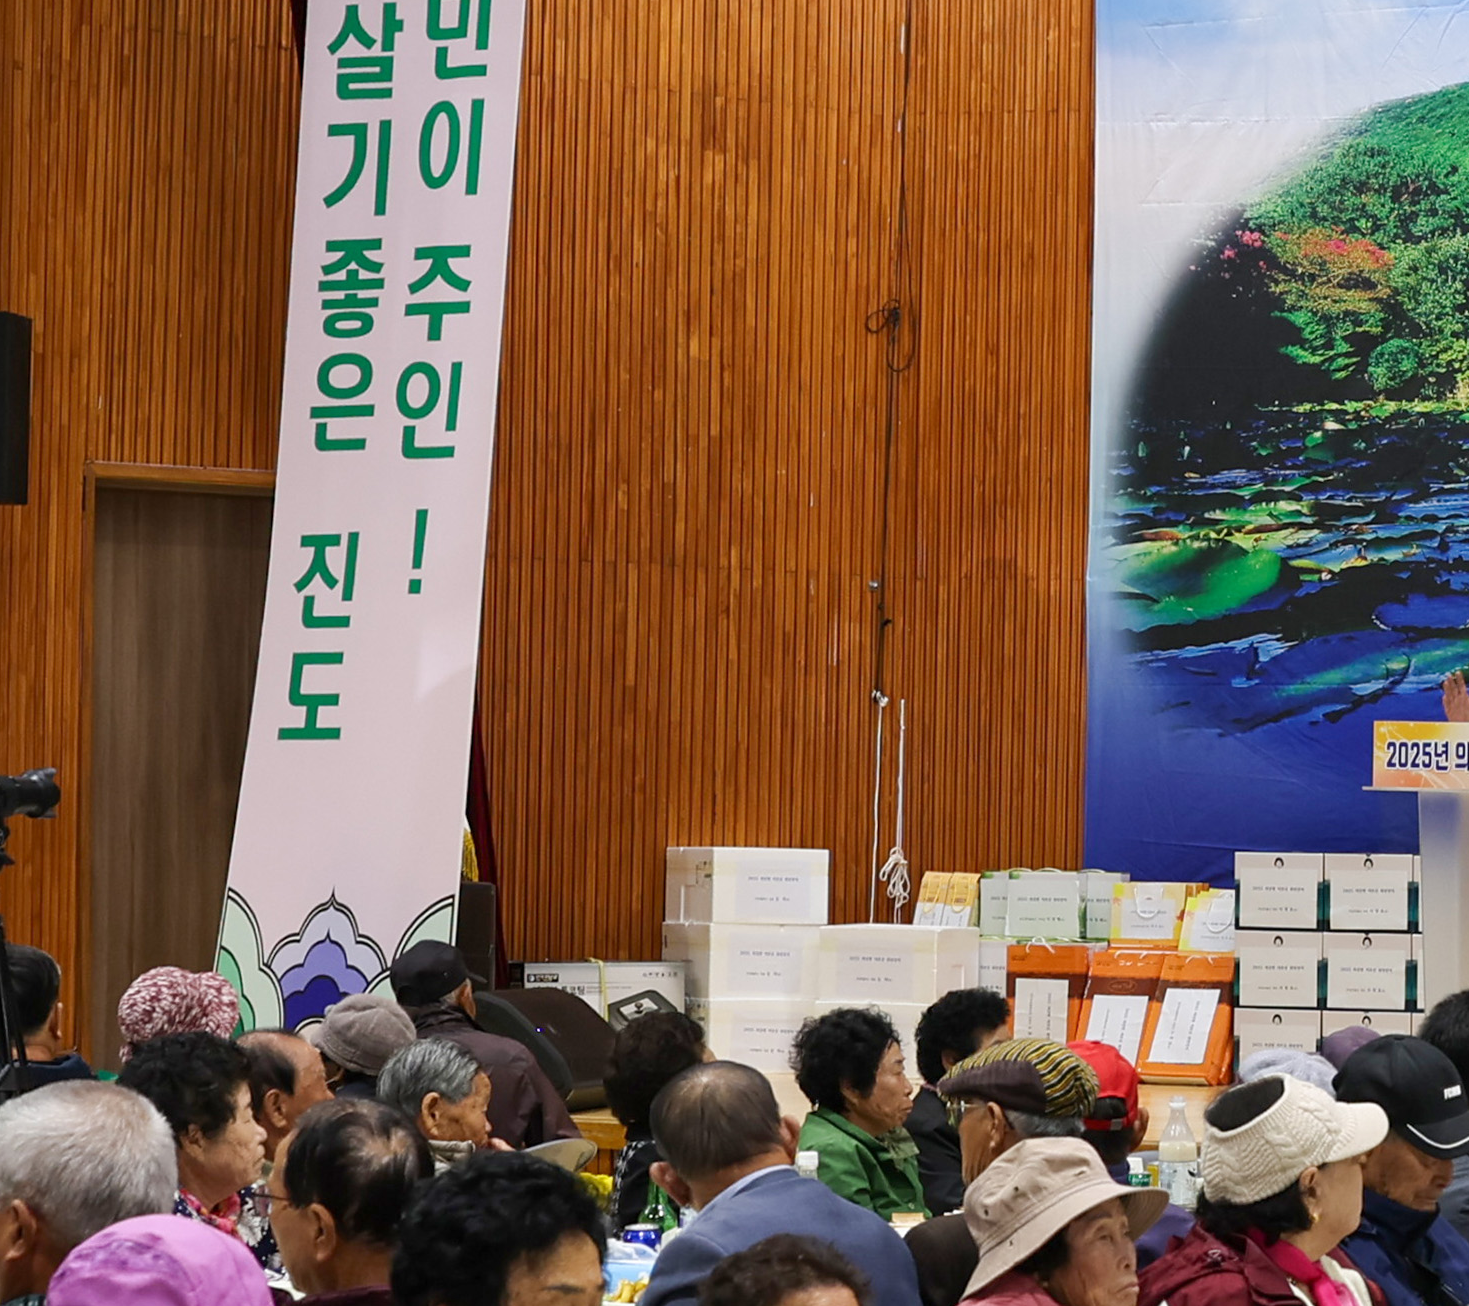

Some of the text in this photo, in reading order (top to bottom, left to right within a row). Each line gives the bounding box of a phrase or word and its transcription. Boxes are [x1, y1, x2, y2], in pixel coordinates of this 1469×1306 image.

[276, 1, 405, 742] 살기좋은 진도
[395, 244, 473, 461] 주인
[1385, 740, 1450, 771] 2025년
